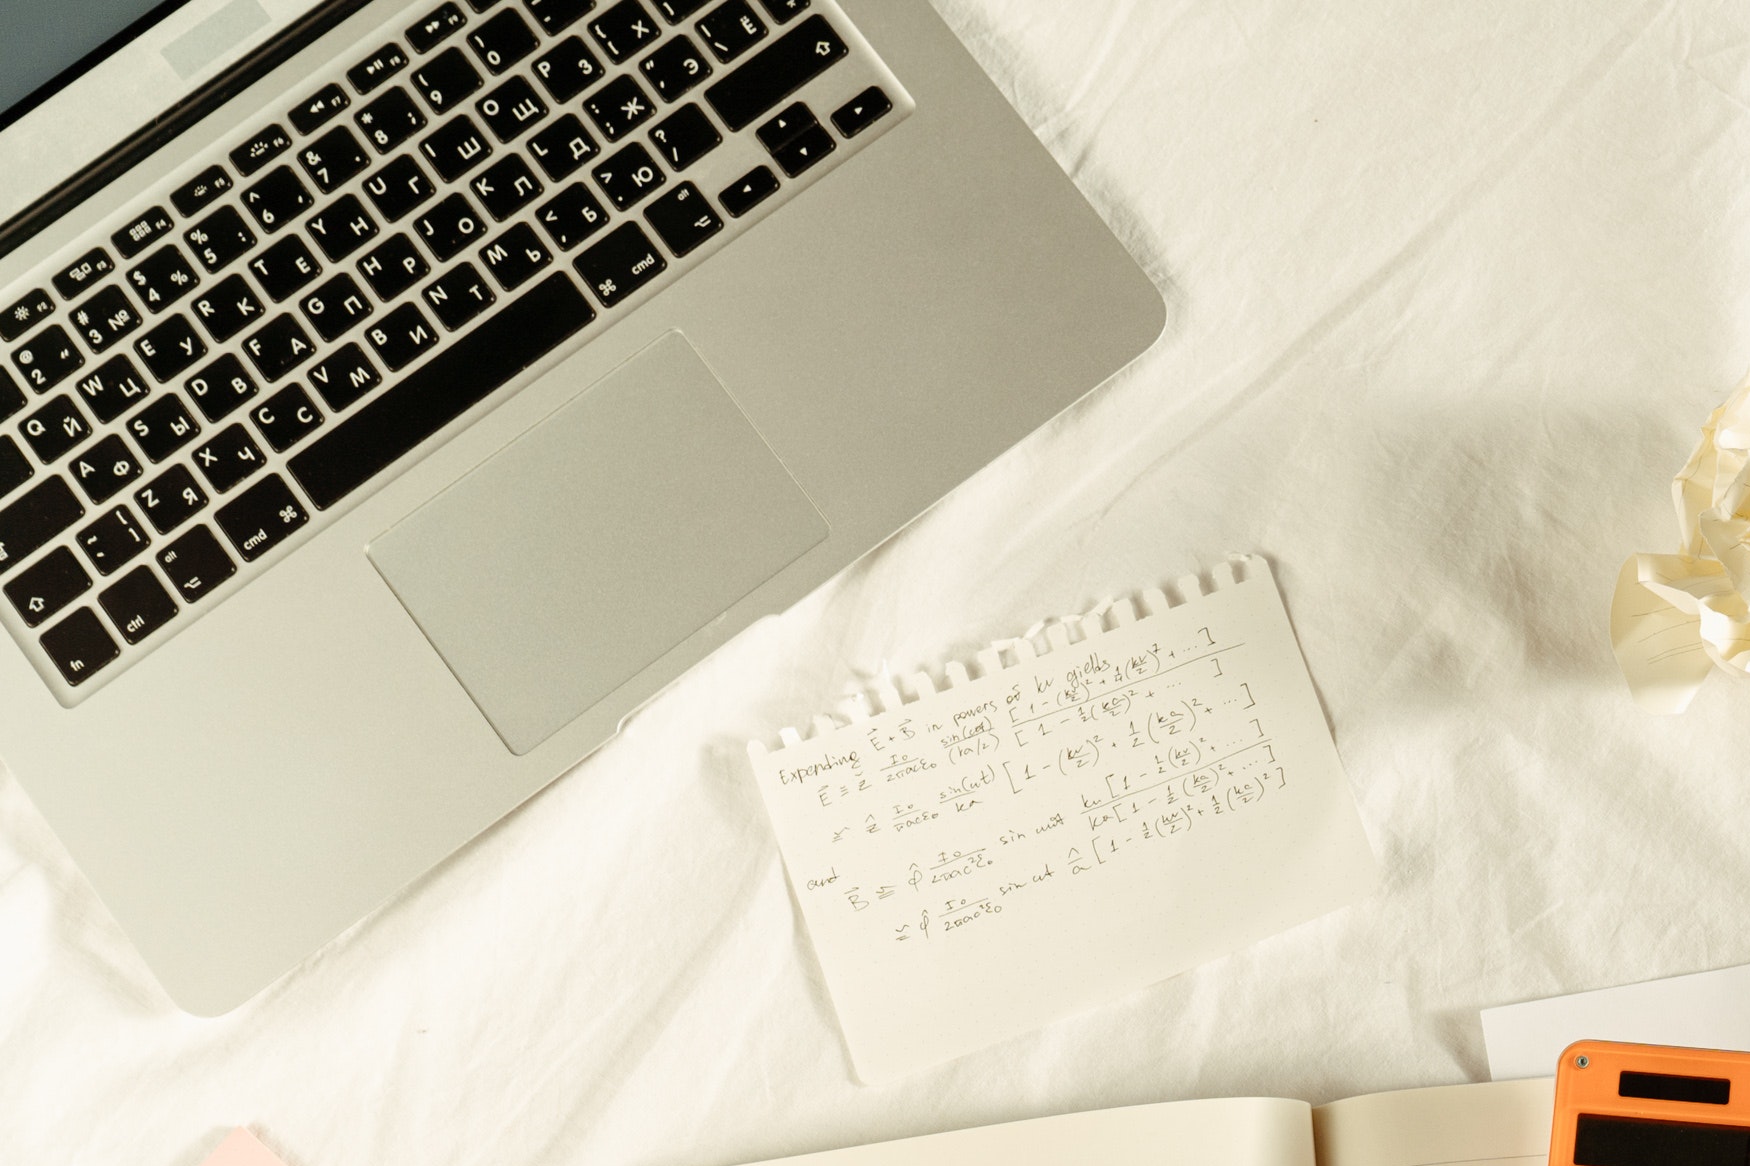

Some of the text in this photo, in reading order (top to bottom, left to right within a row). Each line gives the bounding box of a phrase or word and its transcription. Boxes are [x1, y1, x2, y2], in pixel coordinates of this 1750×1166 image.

[538, 62, 550, 77] P
[431, 91, 442, 104] 9
[375, 130, 388, 144] 8
[533, 143, 548, 156] L
[306, 151, 321, 165] &
[318, 168, 328, 183] 7
[369, 177, 386, 194] U
[476, 178, 494, 195] K
[678, 189, 689, 200] alt
[263, 209, 274, 223] 6
[312, 219, 326, 234] Y
[424, 220, 434, 235] J
[191, 230, 208, 244] %
[204, 248, 216, 263] 5
[487, 245, 507, 264] M
[254, 259, 268, 275] T
[363, 257, 382, 275] H
[632, 254, 654, 274] cmd
[134, 271, 146, 285] $
[171, 271, 188, 285] %
[149, 288, 160, 301] 4
[429, 286, 447, 304] N
[198, 301, 214, 316] R
[308, 298, 324, 314] G
[78, 311, 88, 325] #
[89, 329, 102, 343] 3
[372, 329, 387, 345] B
[141, 340, 155, 356] E
[249, 339, 260, 355] F
[20, 350, 33, 364] @
[32, 369, 46, 384] 2
[314, 366, 328, 382] V
[83, 375, 103, 395] W
[192, 379, 208, 395] D
[259, 408, 274, 423] C
[27, 420, 45, 435] Q
[134, 420, 149, 436] S
[199, 448, 217, 466] X
[80, 461, 95, 477] A
[142, 489, 159, 507] Z
[244, 529, 267, 550] cmd
[165, 551, 177, 562] alt
[127, 615, 144, 632] ctrl
[70, 660, 84, 671] fn
